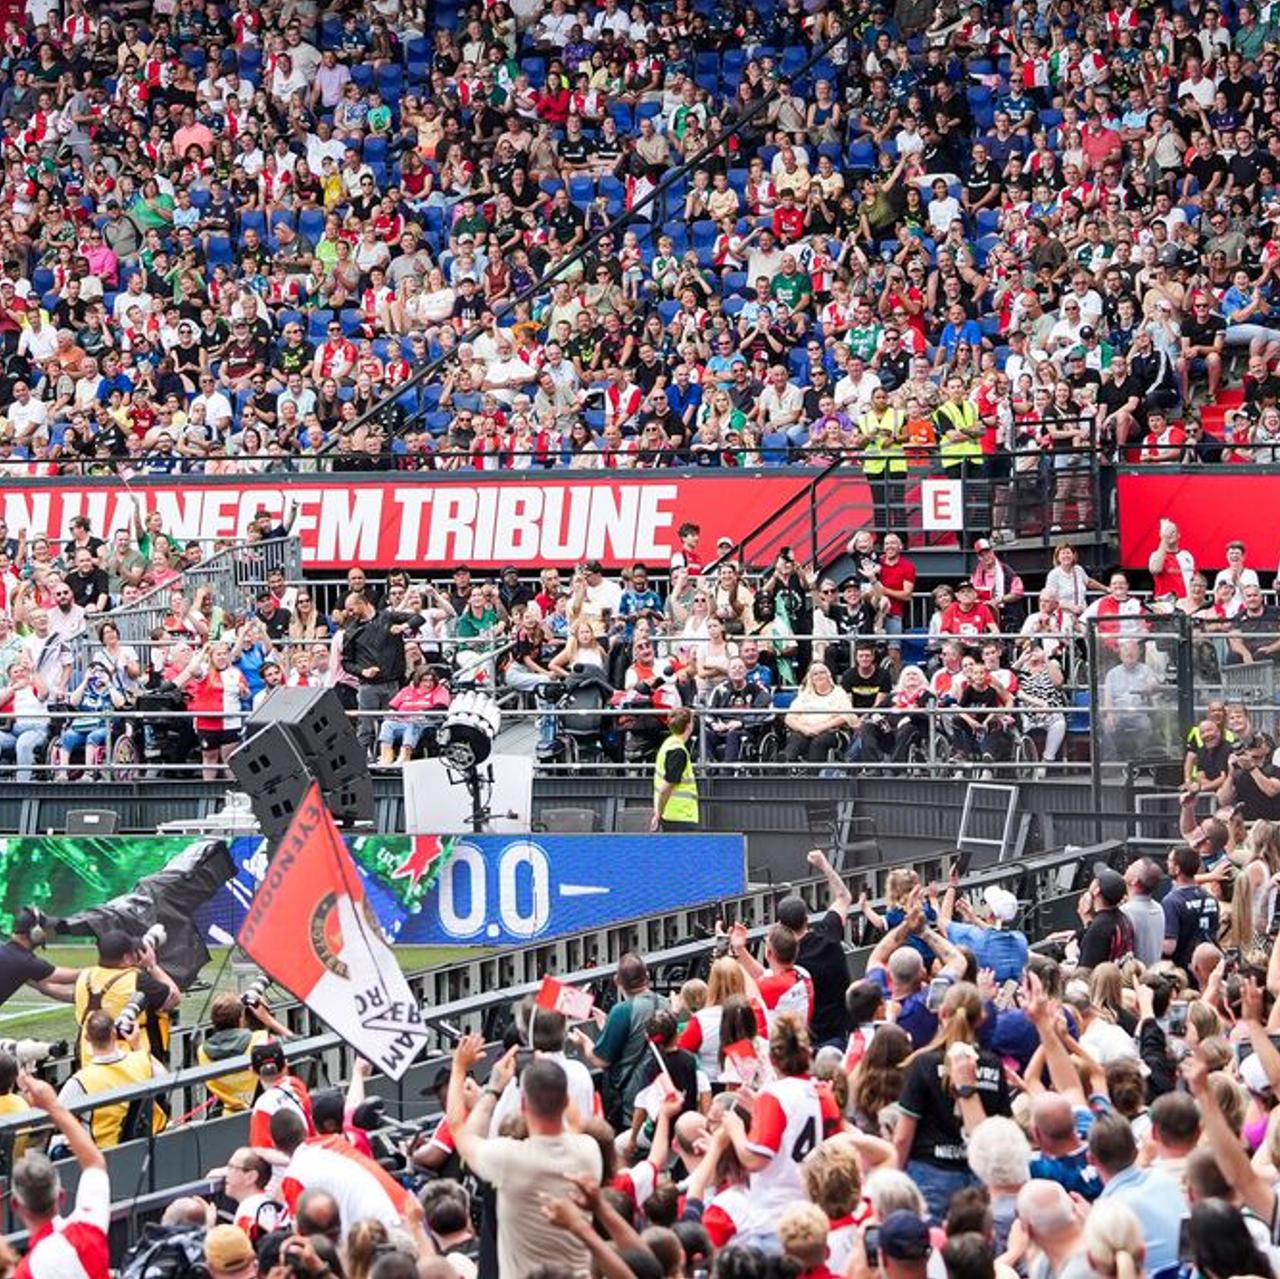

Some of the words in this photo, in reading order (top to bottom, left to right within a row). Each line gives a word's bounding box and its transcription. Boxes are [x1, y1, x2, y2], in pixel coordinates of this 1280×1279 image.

[394, 484, 678, 562] TRIBUNE
[933, 490, 952, 520] E
[242, 804, 320, 945] EYENOORD
[438, 840, 552, 939] 0.0
[791, 1115, 817, 1163] 4
